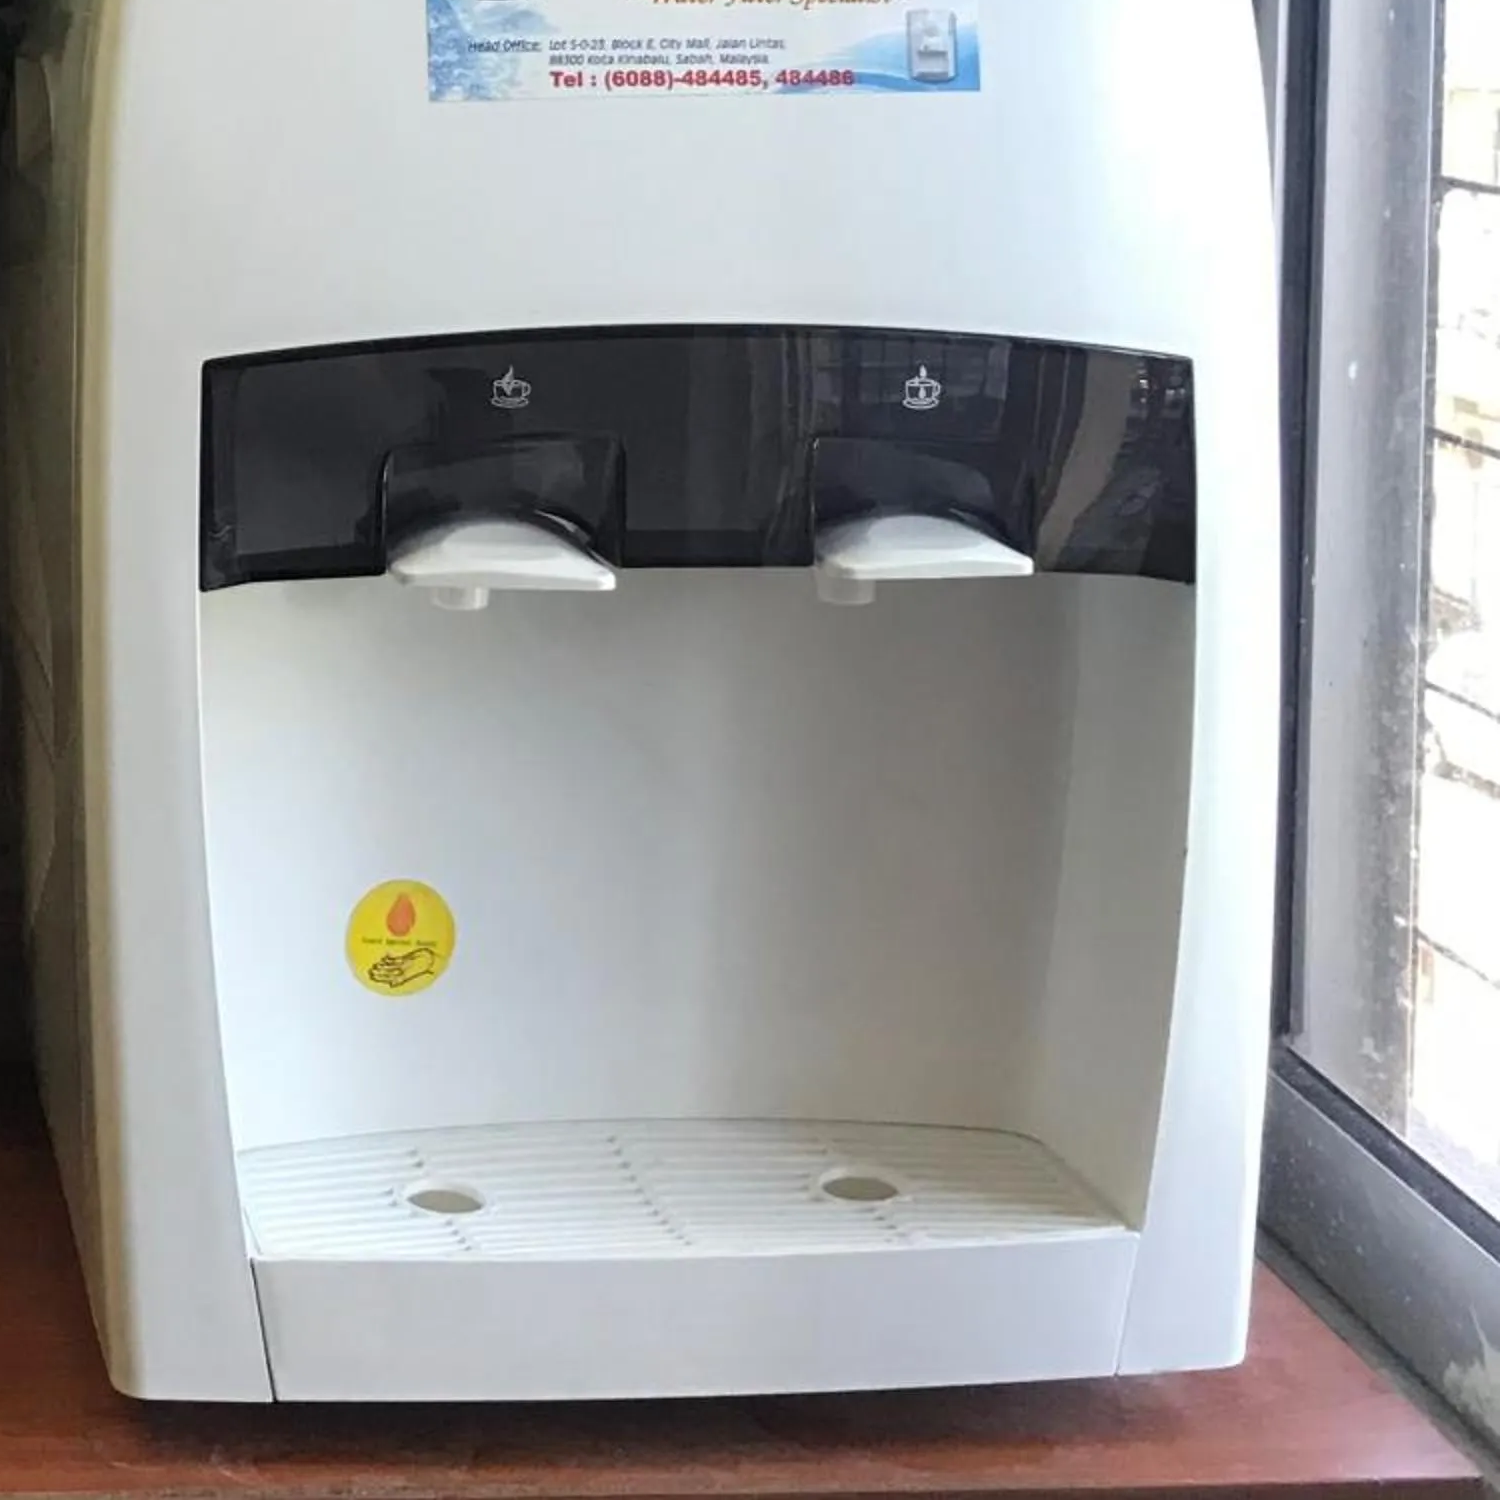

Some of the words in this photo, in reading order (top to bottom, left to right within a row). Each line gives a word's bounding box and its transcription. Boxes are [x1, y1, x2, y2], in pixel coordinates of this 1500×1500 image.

[468, 40, 500, 52] Head
[660, 38, 682, 51] City
[587, 54, 615, 66] Kota
[550, 70, 583, 88] Tel
[605, 70, 769, 91] (6088)-484485,
[775, 70, 854, 87] 484486
